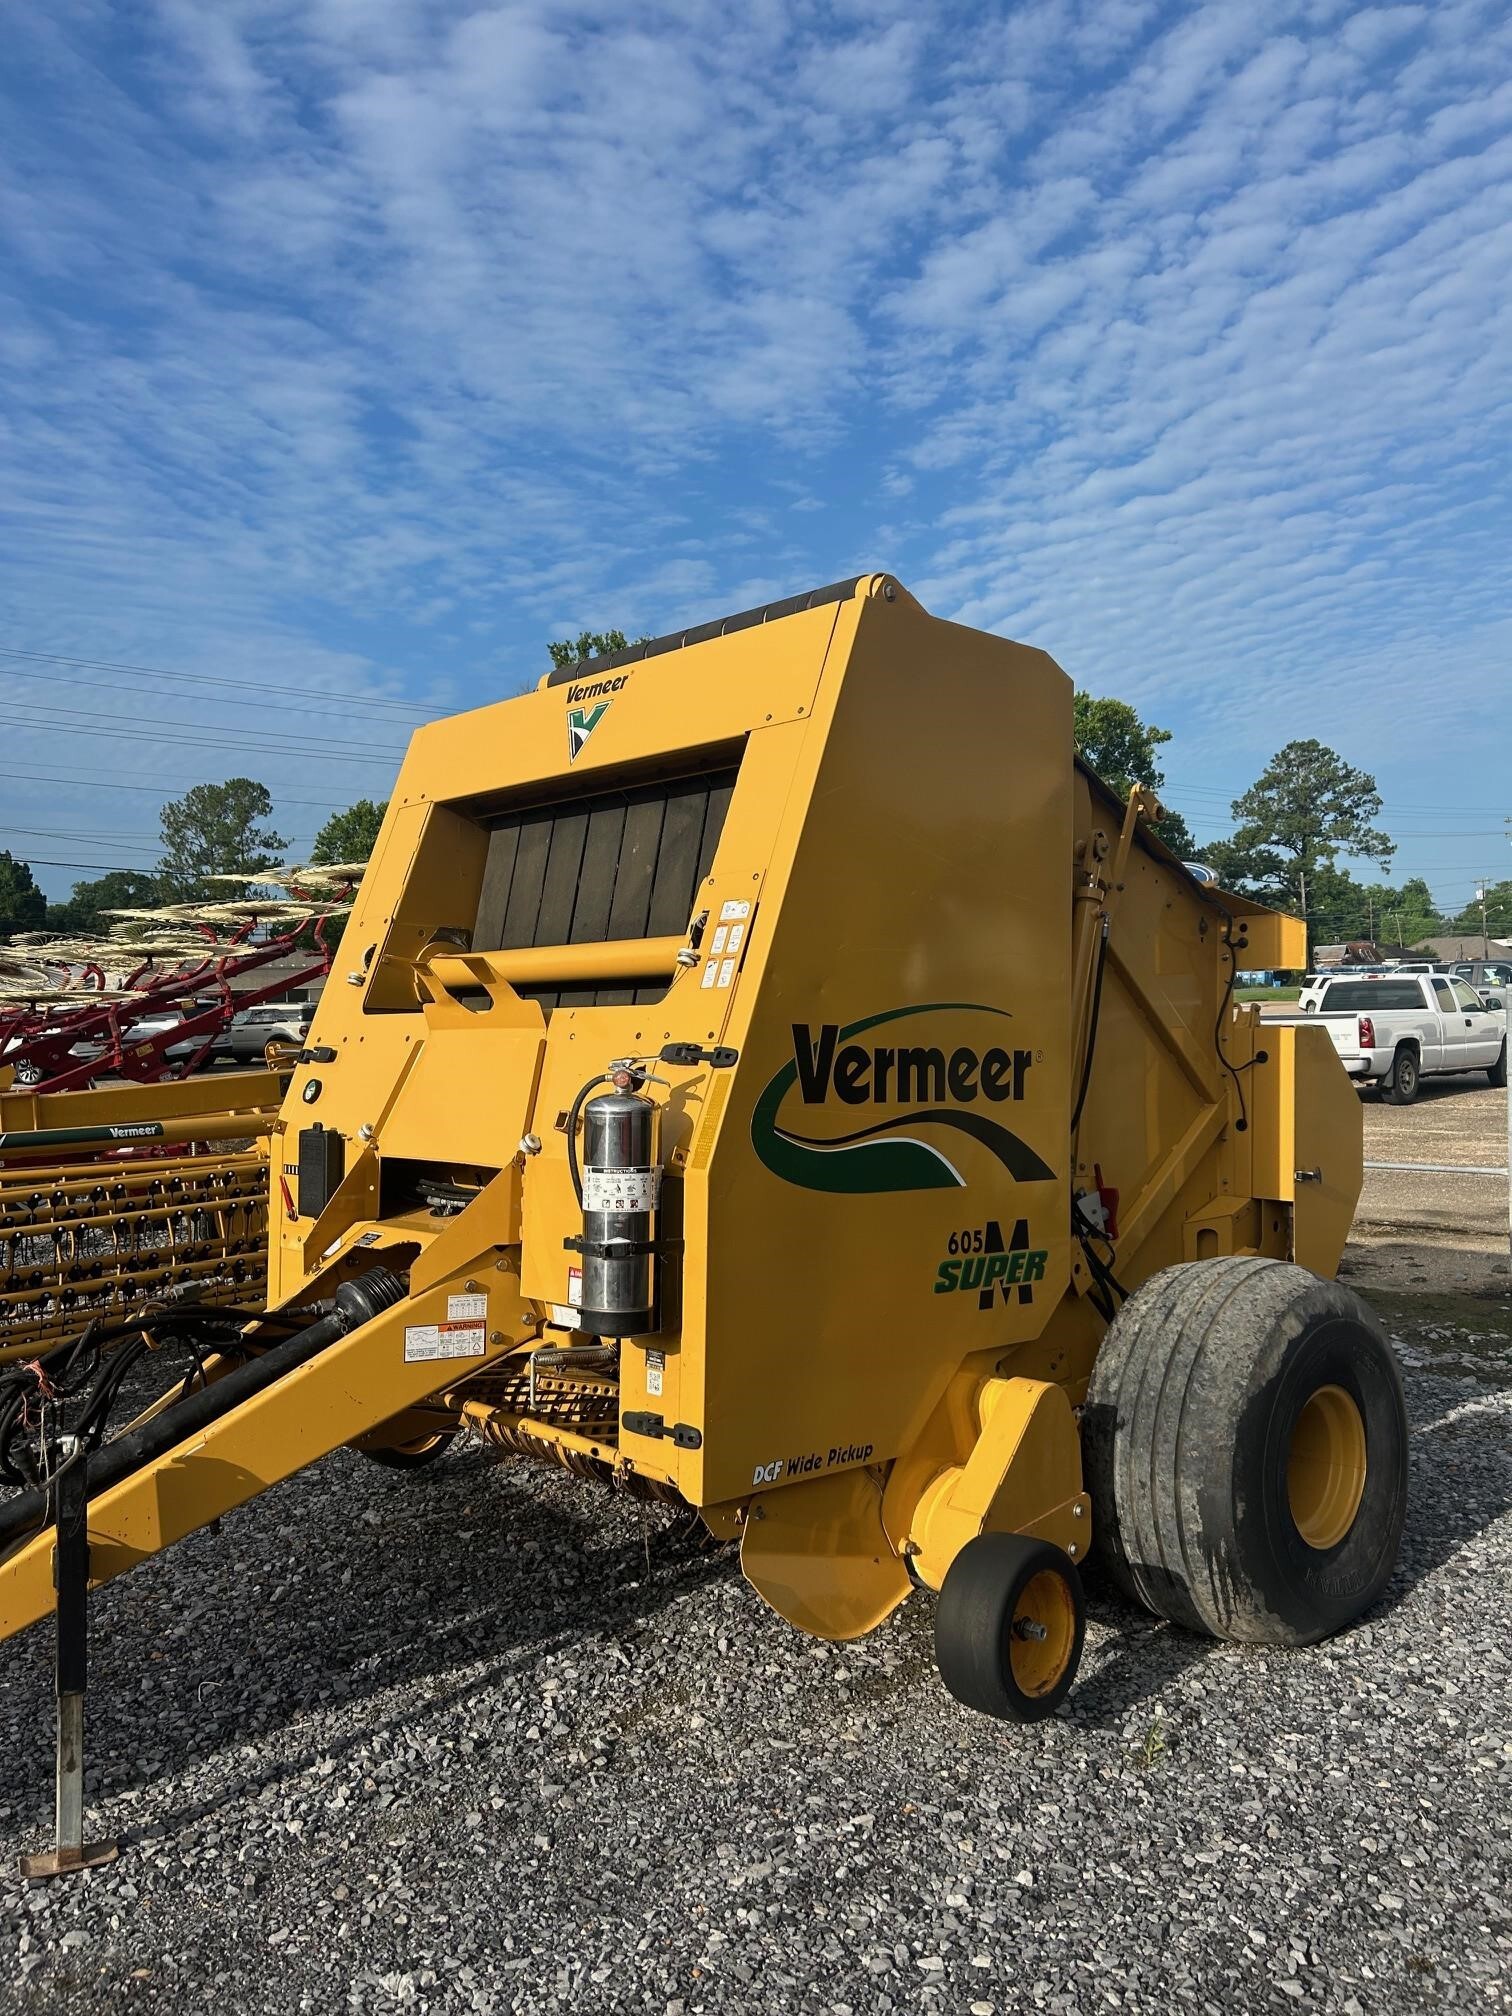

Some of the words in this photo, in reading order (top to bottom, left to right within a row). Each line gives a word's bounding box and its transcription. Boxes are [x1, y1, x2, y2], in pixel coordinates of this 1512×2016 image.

[566, 674, 629, 704] Vermeer
[792, 1023, 1032, 1105] Vermeer
[109, 1125, 157, 1138] Vermeer
[948, 1230, 983, 1255] 605
[934, 1251, 1048, 1294] SUPER
[453, 1322, 483, 1330] WARNING
[752, 1460, 783, 1486] DCF
[786, 1453, 822, 1477] Wide
[827, 1444, 873, 1467] Pickup
